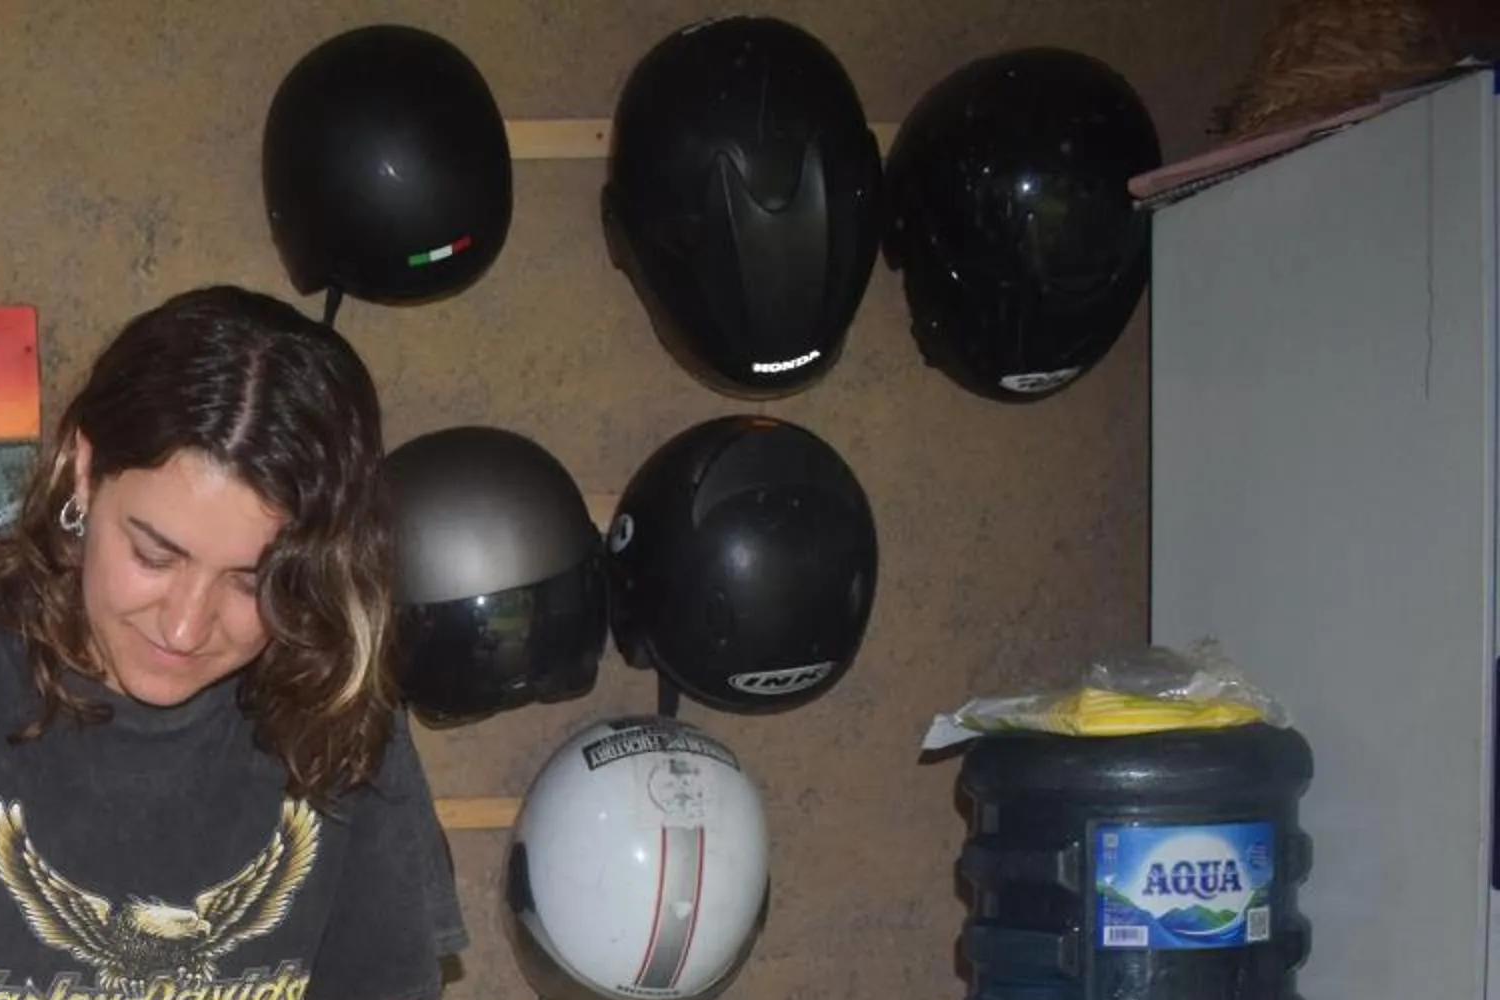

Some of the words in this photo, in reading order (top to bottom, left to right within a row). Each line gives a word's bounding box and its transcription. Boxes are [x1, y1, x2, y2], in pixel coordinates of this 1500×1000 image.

[752, 350, 820, 373] HONDA
[738, 668, 822, 690] INK
[1142, 859, 1243, 899] AQUA
